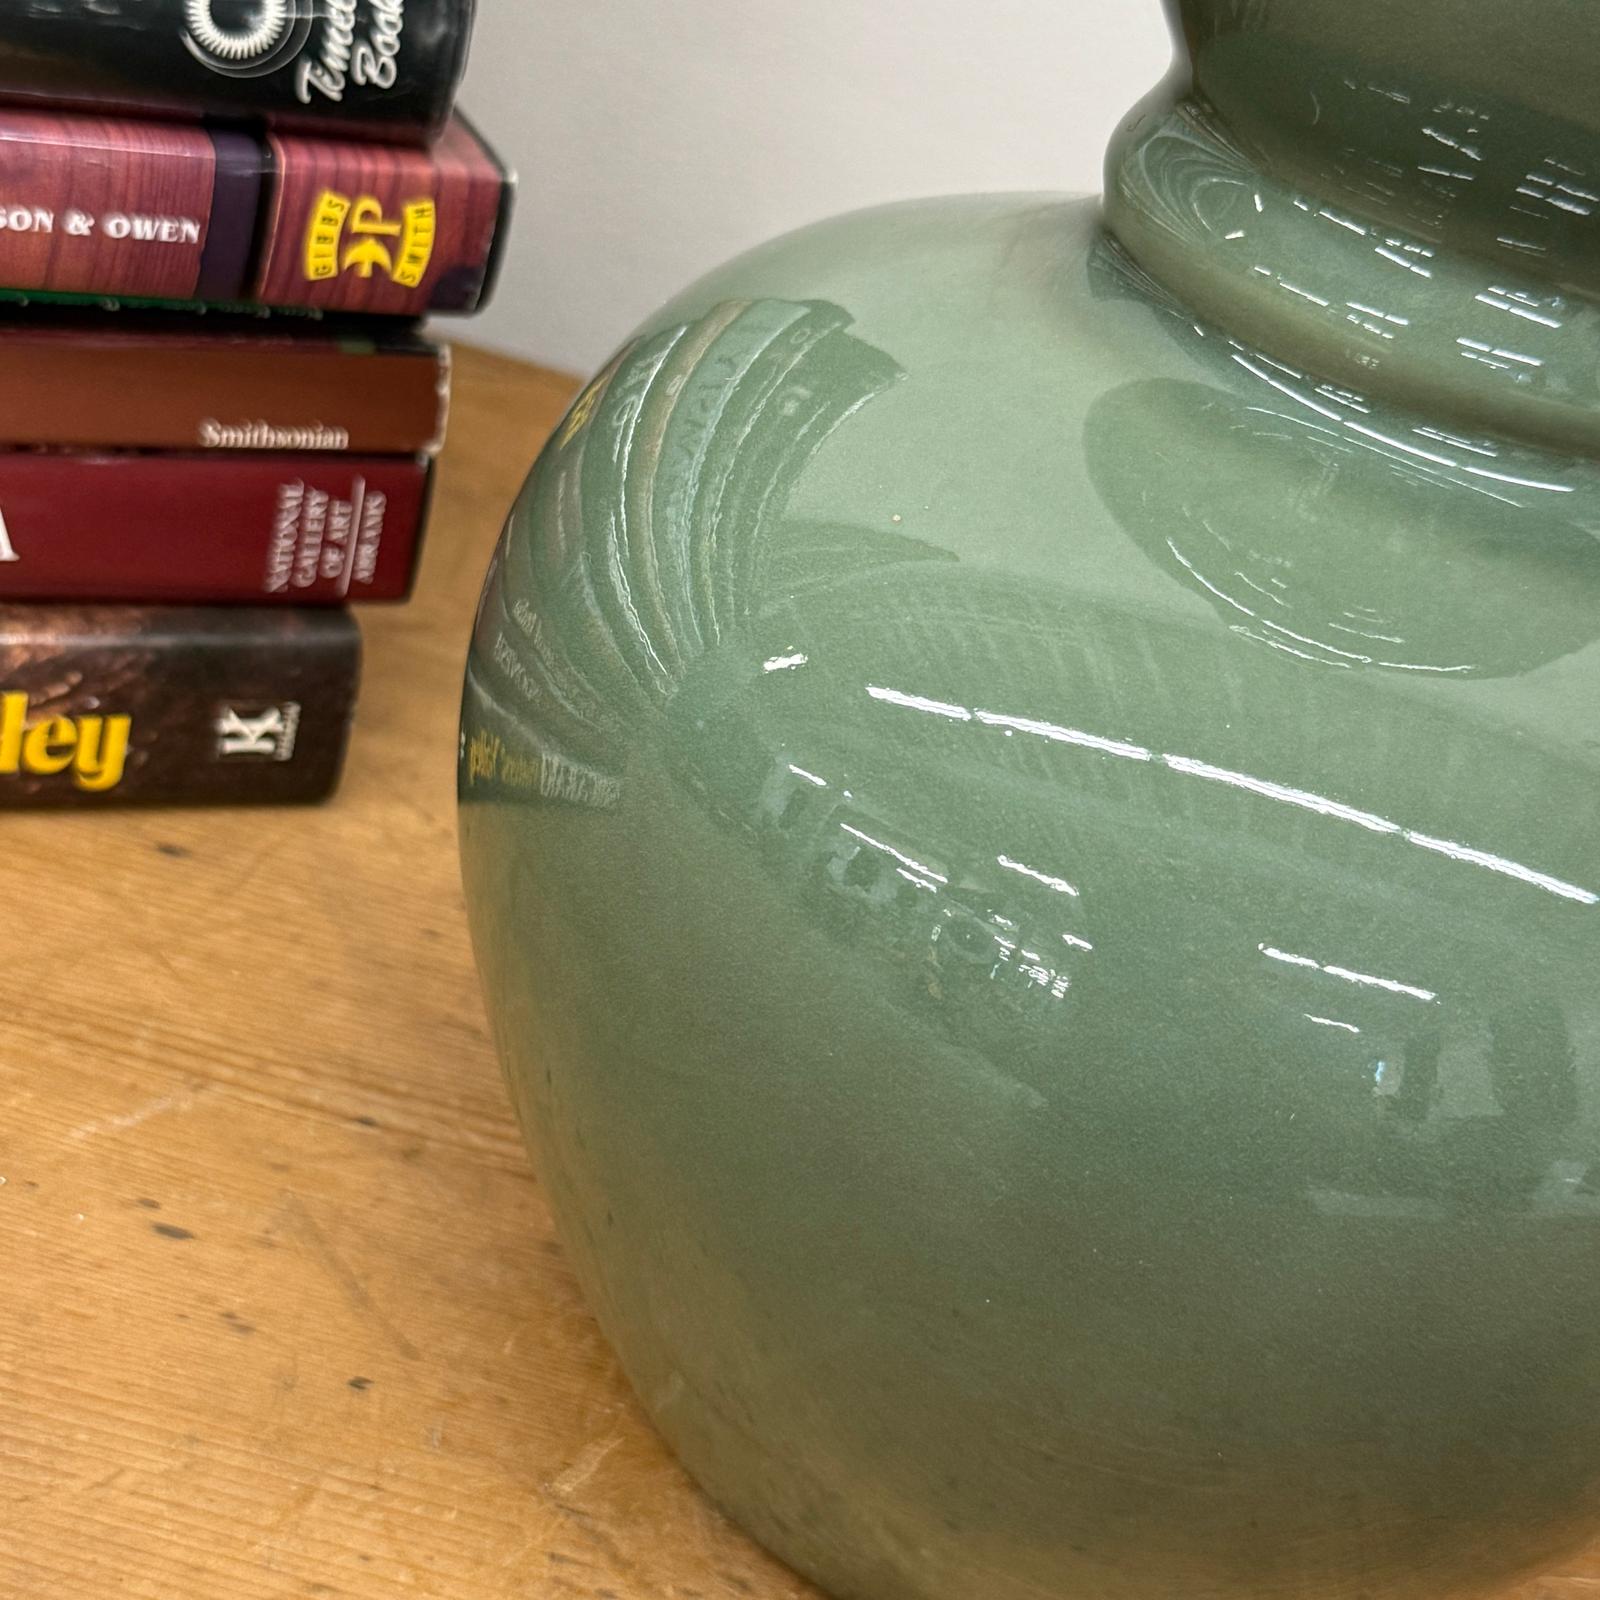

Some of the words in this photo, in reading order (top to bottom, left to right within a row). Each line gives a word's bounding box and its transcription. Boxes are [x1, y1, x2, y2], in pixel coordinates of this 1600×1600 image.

[67, 209, 95, 236] &
[103, 213, 200, 244] OWEN
[311, 198, 346, 278] GIBBS
[398, 206, 434, 284] SMITH
[199, 418, 349, 449] Smithsonian
[263, 478, 304, 593] NATIONAL
[291, 487, 328, 587] GALLERY
[325, 499, 352, 546] ART
[320, 546, 344, 578] OF
[216, 706, 284, 754] K
